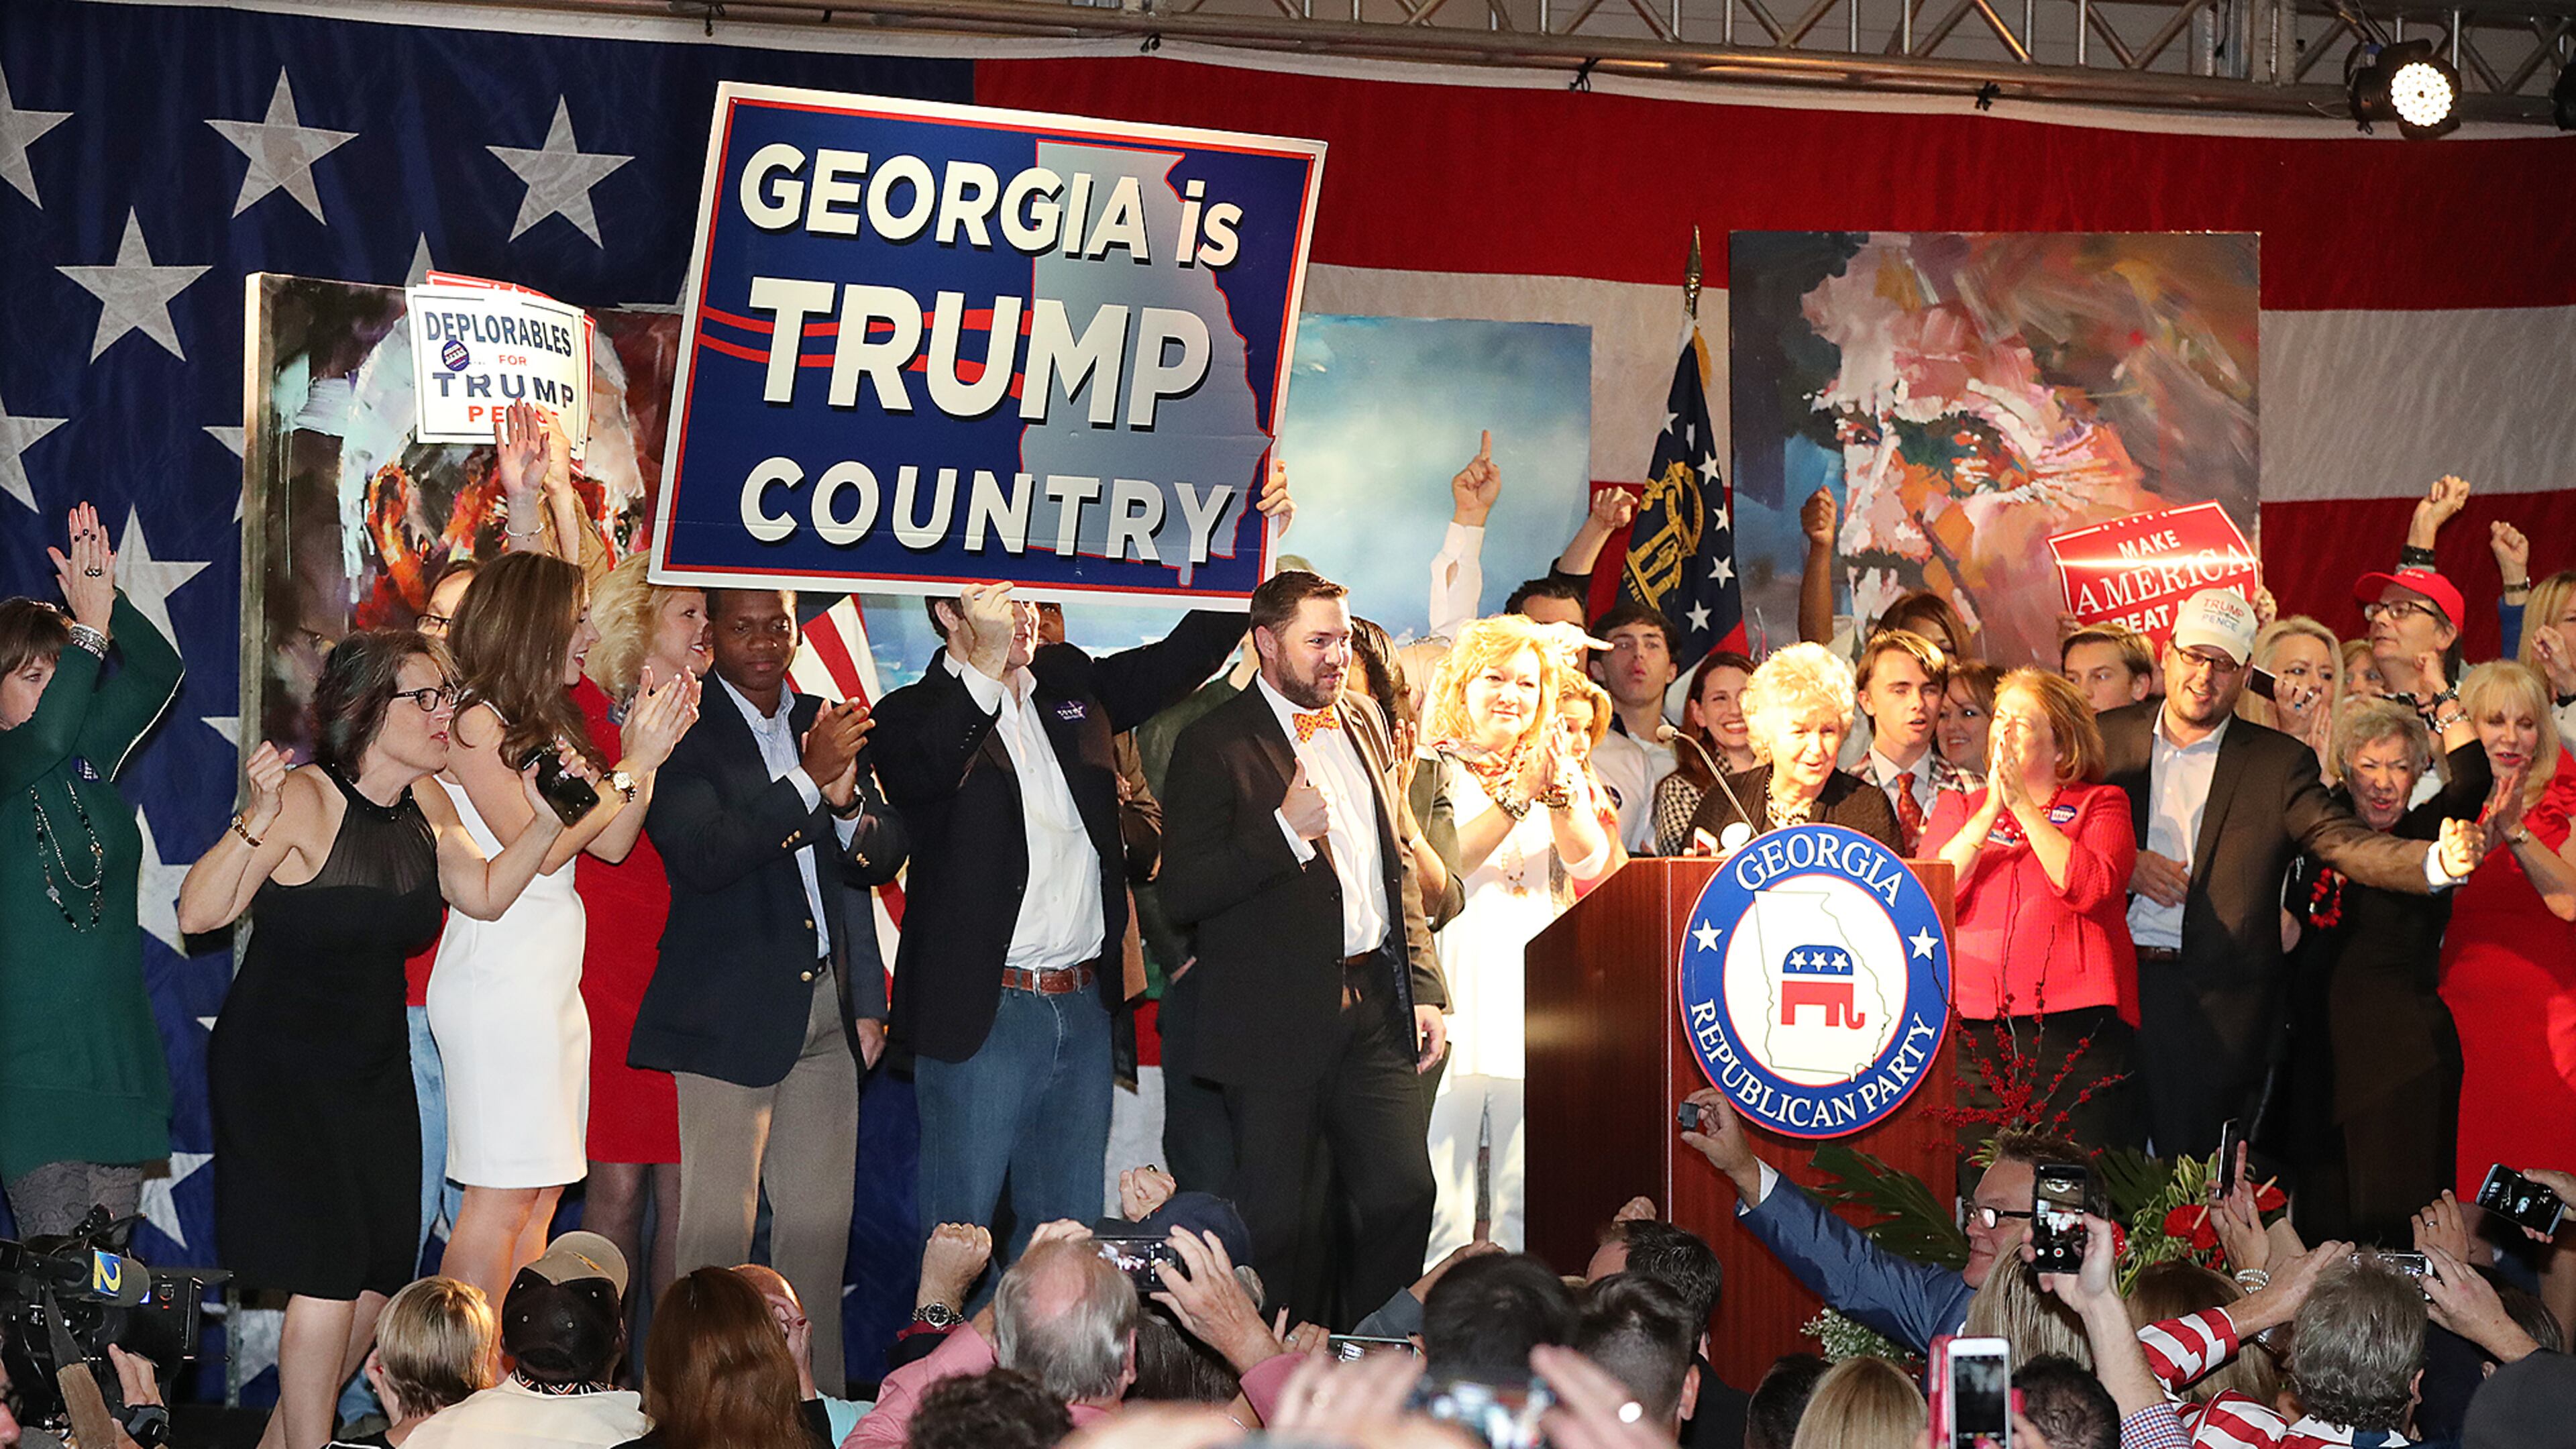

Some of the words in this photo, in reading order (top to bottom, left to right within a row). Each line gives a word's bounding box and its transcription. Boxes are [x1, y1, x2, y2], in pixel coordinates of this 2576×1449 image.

[739, 143, 1149, 262] GEORGIA
[1175, 180, 1242, 266] is
[425, 311, 572, 357] DEPLORABLES
[748, 276, 1210, 428] TRUMP
[498, 355, 527, 366] FOR
[433, 372, 574, 408] TRUMP
[739, 457, 1234, 564] COUNTRY
[2117, 530, 2180, 560] MAKE
[2076, 543, 2252, 616] AMERICA
[2096, 604, 2169, 634] EAT
[2202, 614, 2239, 633] PENCE
[2204, 598, 2245, 617] TRUMP
[1735, 833, 1904, 908] GEORGIA
[1690, 998, 1857, 1128] REPUBLICAN
[1858, 1012, 1936, 1114] PARTY
